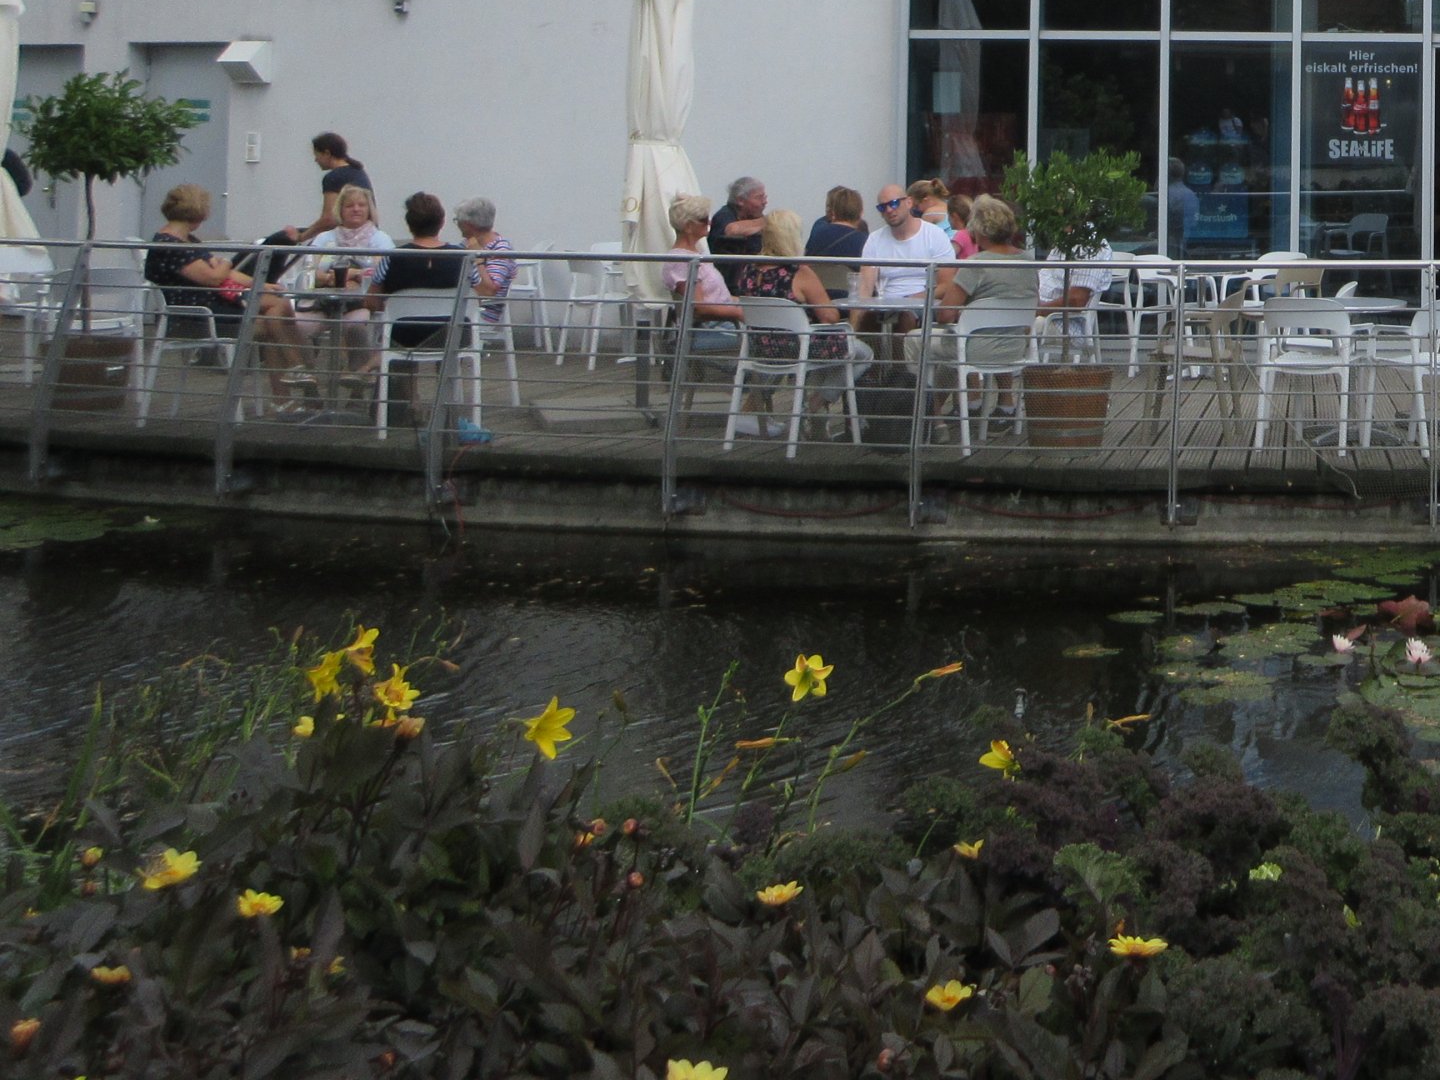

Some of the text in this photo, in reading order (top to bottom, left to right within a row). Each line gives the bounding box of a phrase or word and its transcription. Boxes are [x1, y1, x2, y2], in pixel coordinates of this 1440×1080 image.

[1349, 50, 1375, 61] Hier
[1305, 62, 1418, 73] eiskalt erfrischen!
